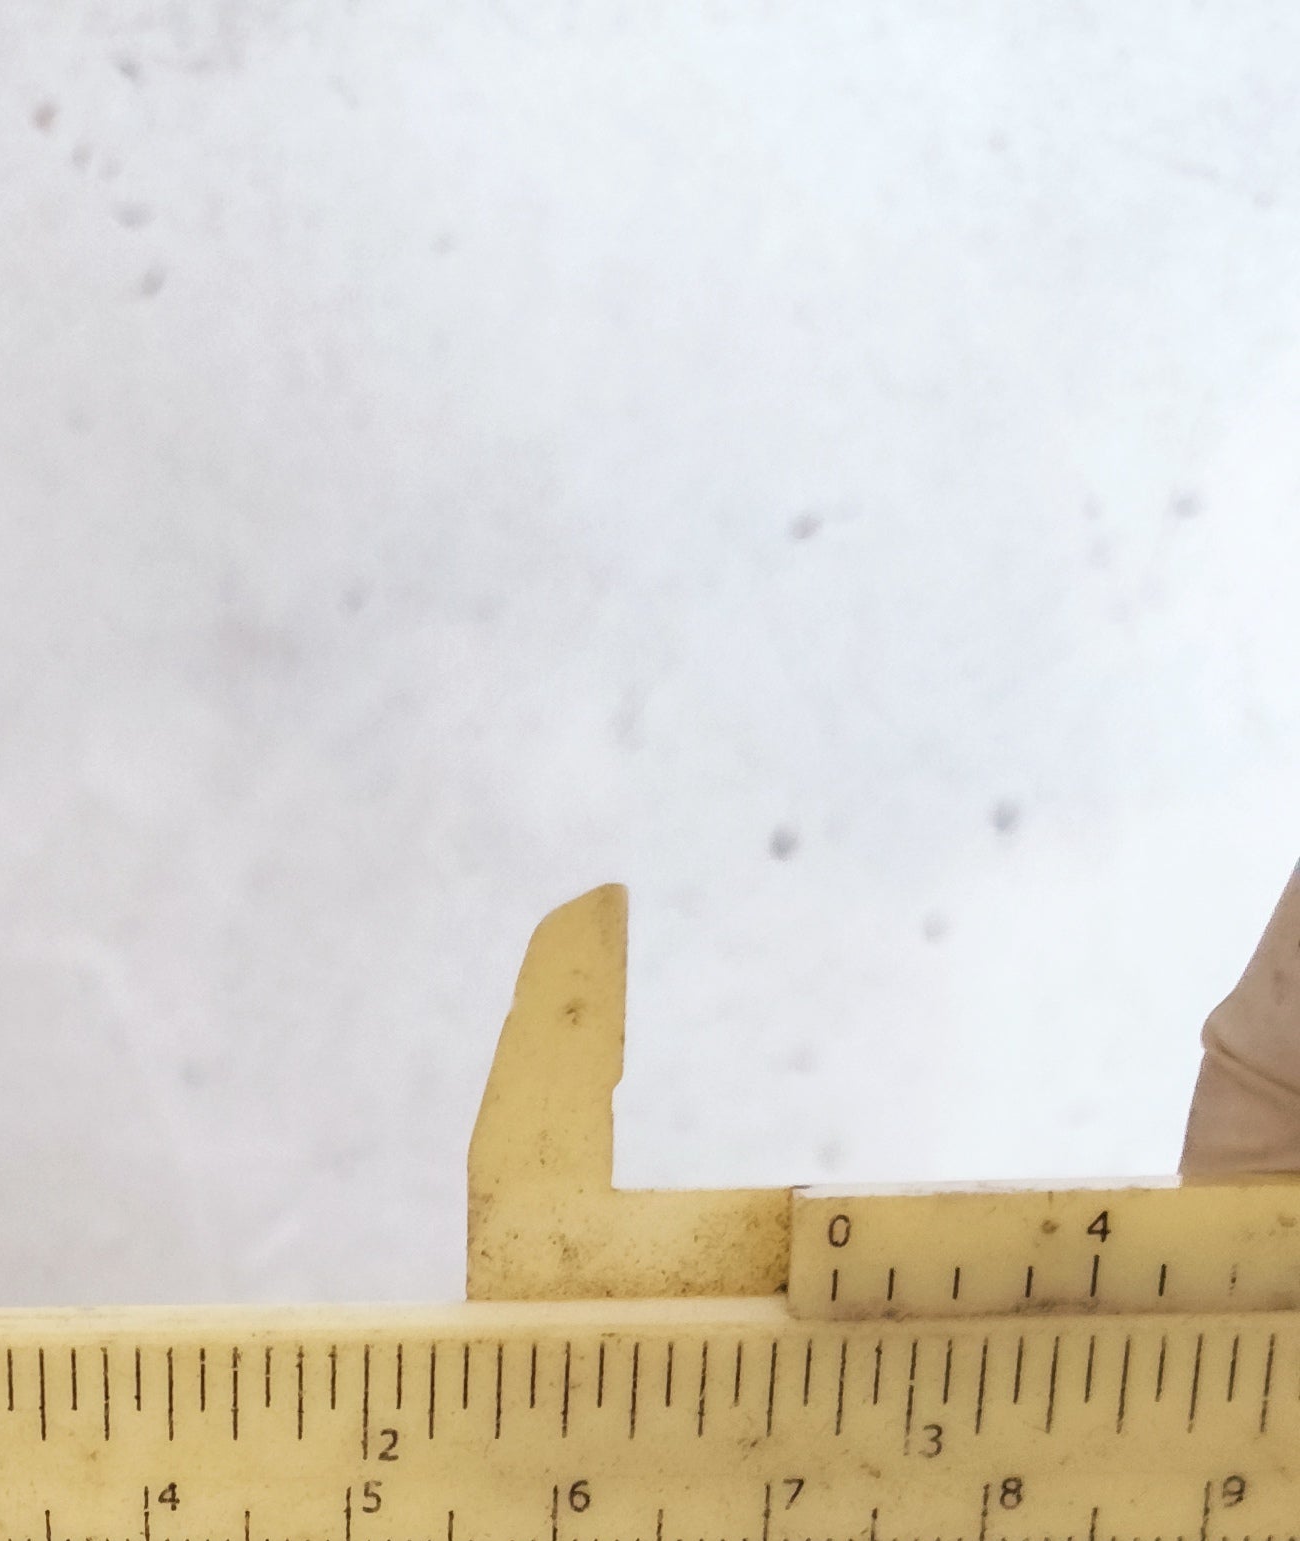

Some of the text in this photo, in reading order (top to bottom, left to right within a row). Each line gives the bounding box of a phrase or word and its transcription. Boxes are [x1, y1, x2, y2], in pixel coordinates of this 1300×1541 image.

[828, 1210, 1112, 1248] 0 4
[378, 1428, 399, 1462] 2
[923, 1423, 943, 1458] 3
[157, 1482, 181, 1512] 4
[362, 1480, 382, 1514] 5
[568, 1479, 591, 1513] 6
[783, 1478, 805, 1510] 7
[999, 1476, 1023, 1506] 8
[1222, 1474, 1247, 1507] 9
